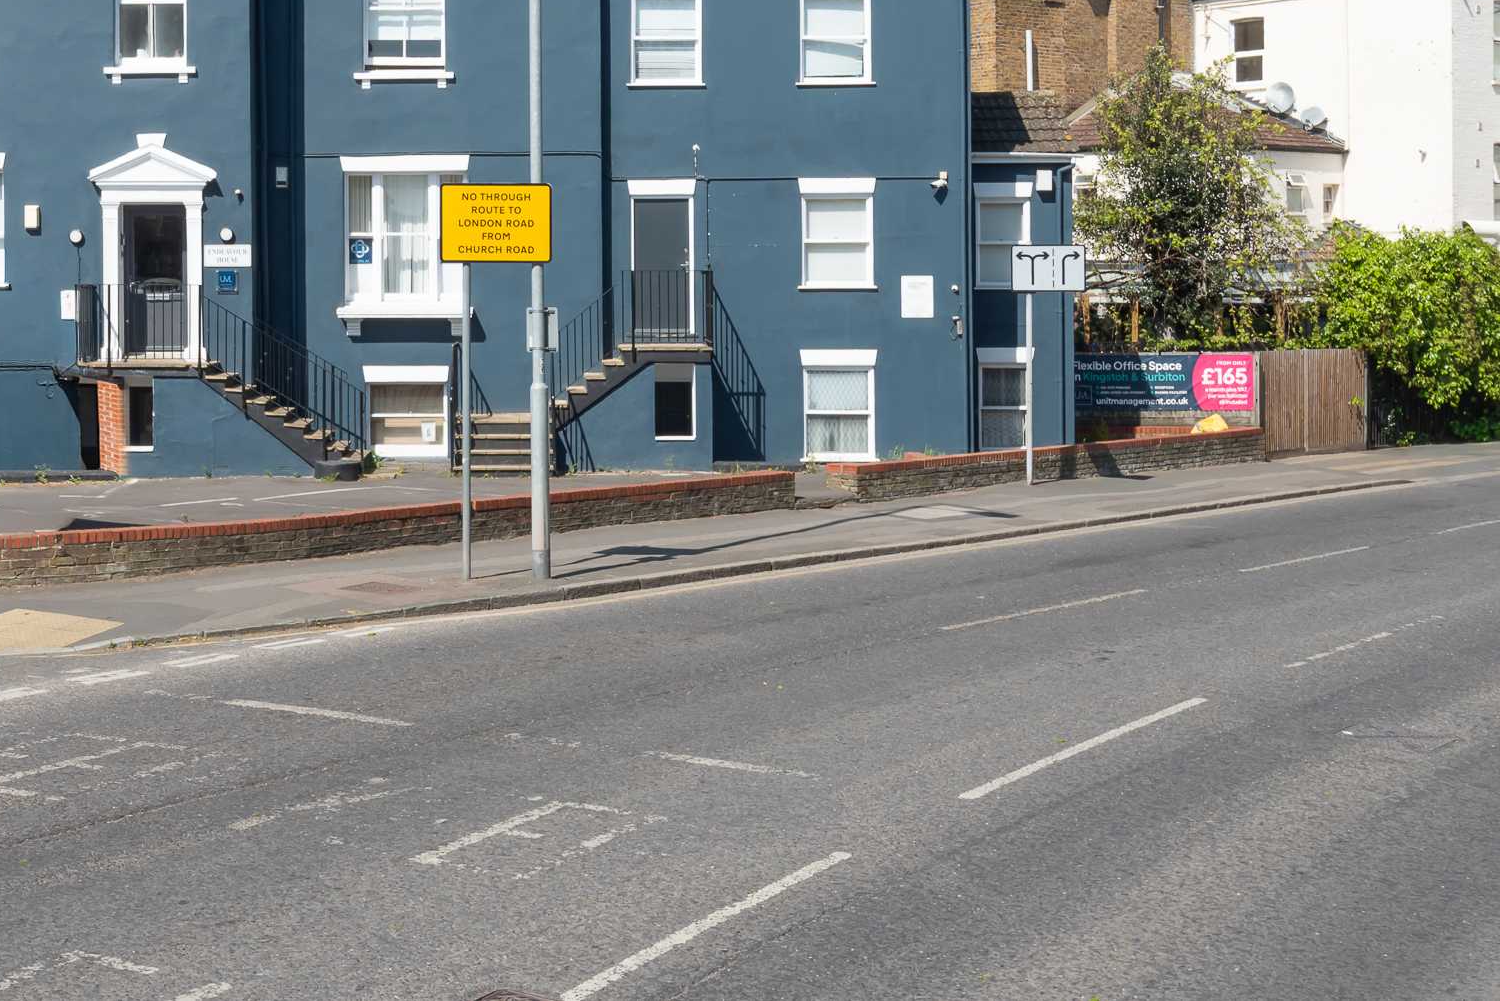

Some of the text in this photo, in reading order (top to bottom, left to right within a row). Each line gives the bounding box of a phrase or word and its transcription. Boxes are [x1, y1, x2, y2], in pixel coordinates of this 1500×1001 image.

[461, 193, 531, 201] NO THROUGH
[471, 206, 522, 214] ROUTE TO
[458, 219, 535, 227] LONDON ROAD
[481, 232, 511, 240] FROM
[458, 245, 535, 254] CHURCH ROAD
[1074, 361, 1182, 372] Flexible Office Space
[1083, 372, 1129, 383] Kingston
[1142, 372, 1186, 381] Surbiton
[1201, 367, 1248, 385] £165
[1096, 397, 1189, 406] unitmanagement.co.uk
